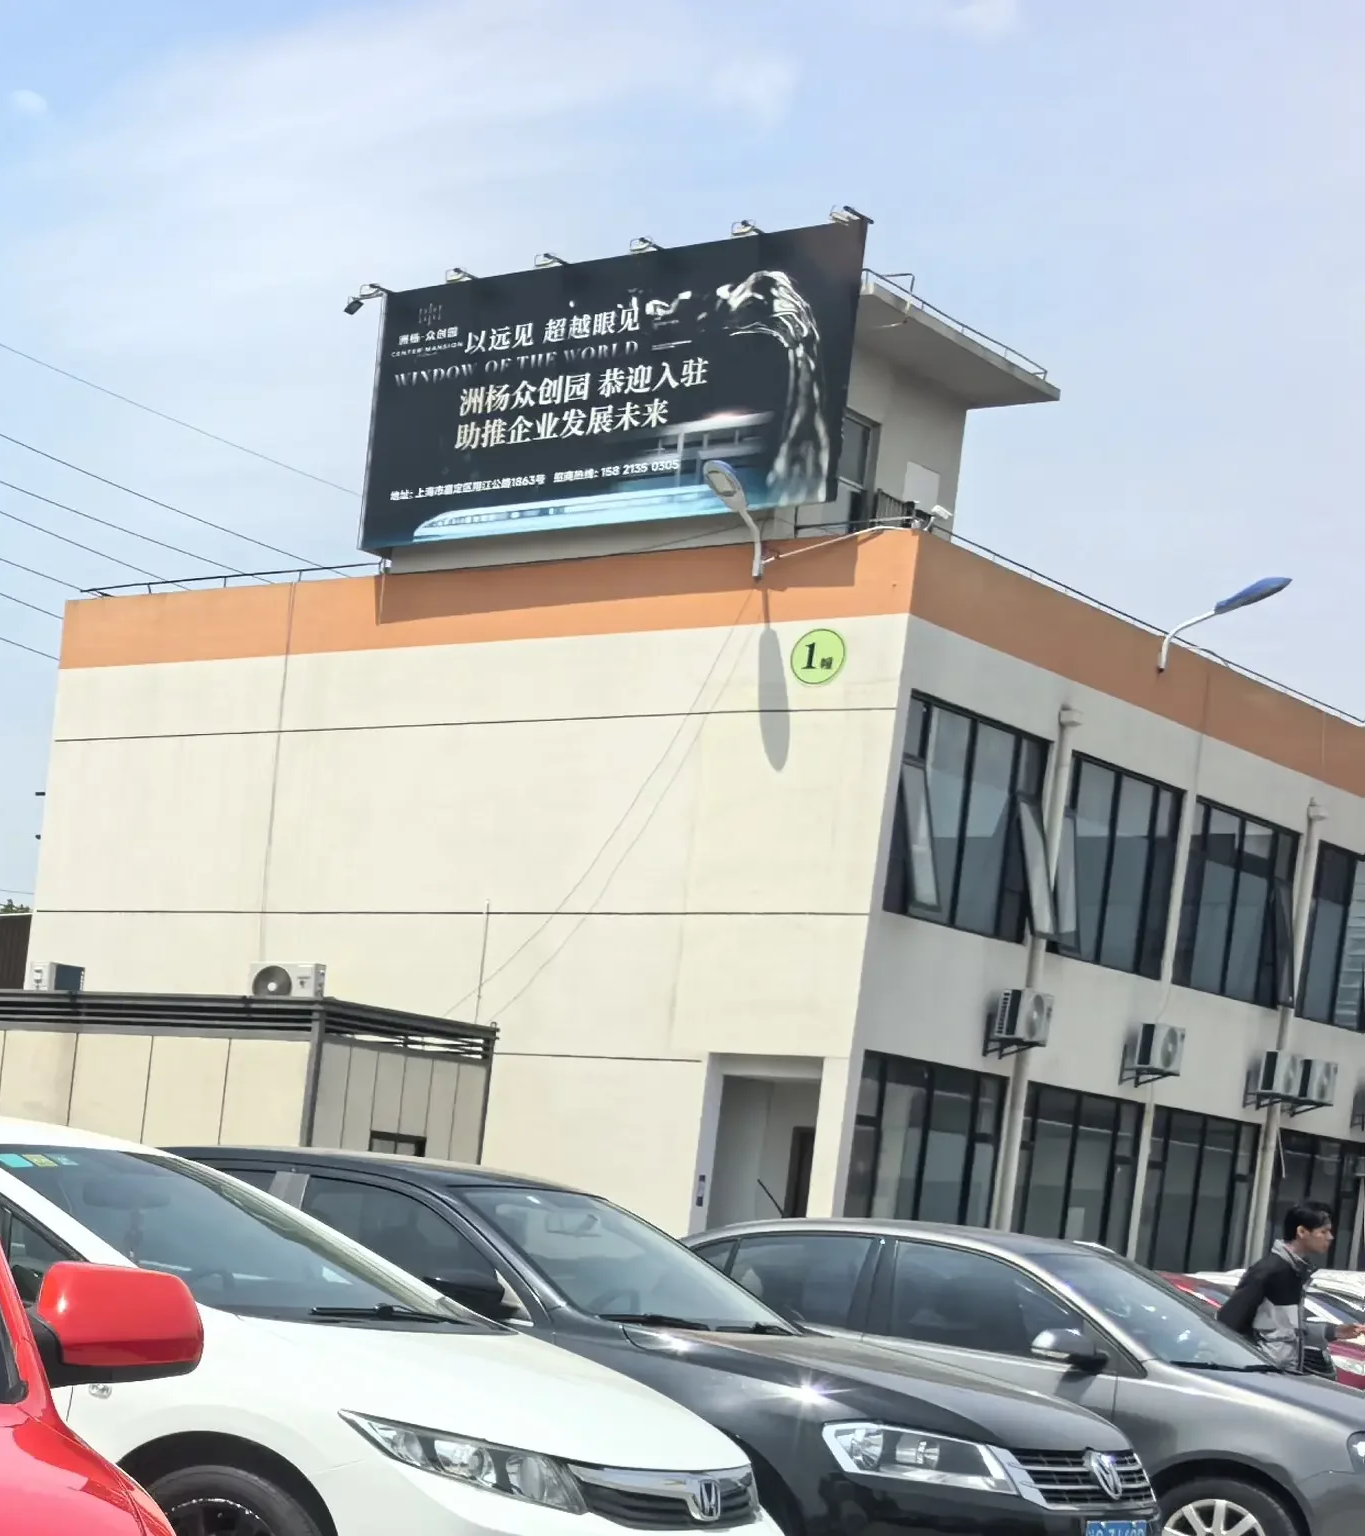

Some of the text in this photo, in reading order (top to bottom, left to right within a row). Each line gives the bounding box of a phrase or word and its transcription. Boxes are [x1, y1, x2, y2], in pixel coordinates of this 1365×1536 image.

[425, 342, 463, 352] MANSION
[464, 308, 640, 354] 以远见 超越眼见
[394, 340, 639, 387] WINDOW OF THE WORLD
[459, 356, 709, 417] 洲杨众创园 恭迎入驻
[454, 397, 669, 451] 助推企业发展未来
[600, 465, 621, 478] 158
[622, 462, 649, 476] 2135
[651, 458, 681, 472] 0305
